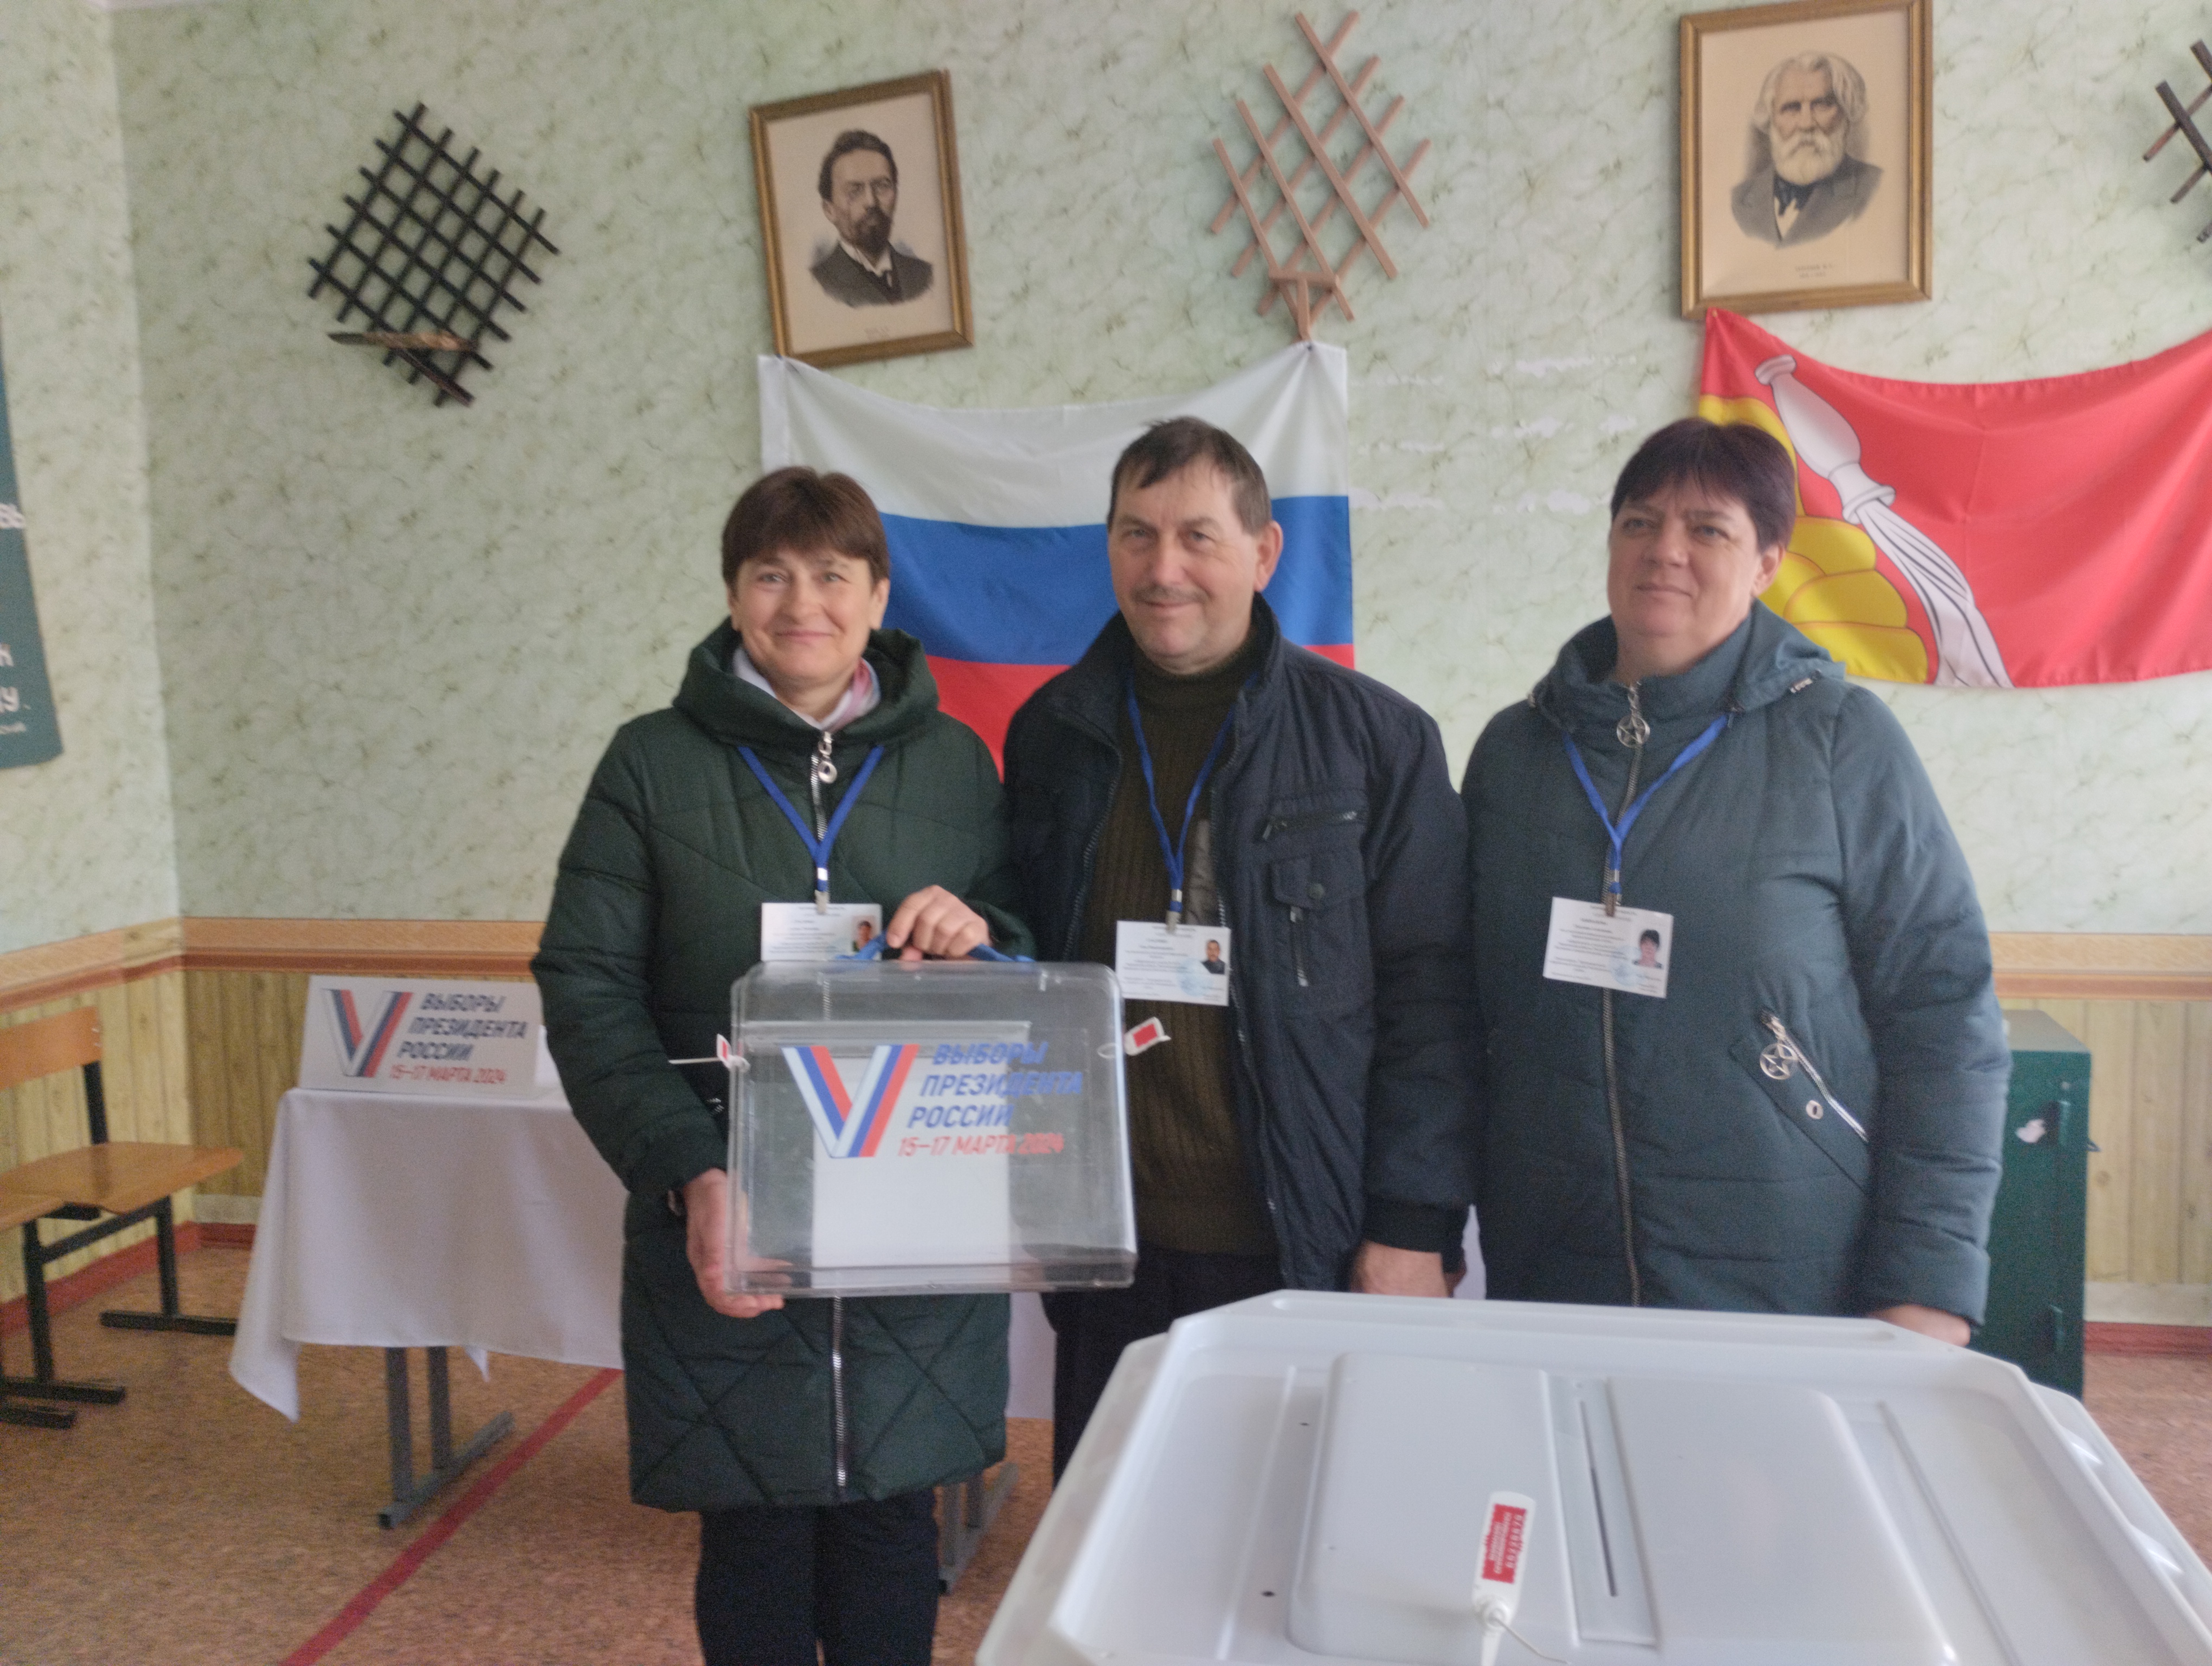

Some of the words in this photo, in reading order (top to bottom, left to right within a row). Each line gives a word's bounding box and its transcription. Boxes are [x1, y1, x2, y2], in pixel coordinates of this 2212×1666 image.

[420, 993, 506, 1013] ВЫБОРЫ
[407, 1017, 527, 1039] ПРЕЗИДЕНТА
[397, 1041, 473, 1060] РОССИИ
[933, 1042, 1049, 1065] ВЫБОРЫ
[427, 1066, 471, 1082] МАРТА
[472, 1067, 507, 1084] 2024
[919, 1072, 1083, 1098] ПРЕЗИДЕНТА
[907, 1105, 1015, 1128] РОССИИ
[951, 1134, 1017, 1155] МАРТА
[1017, 1132, 1065, 1155] 2024
